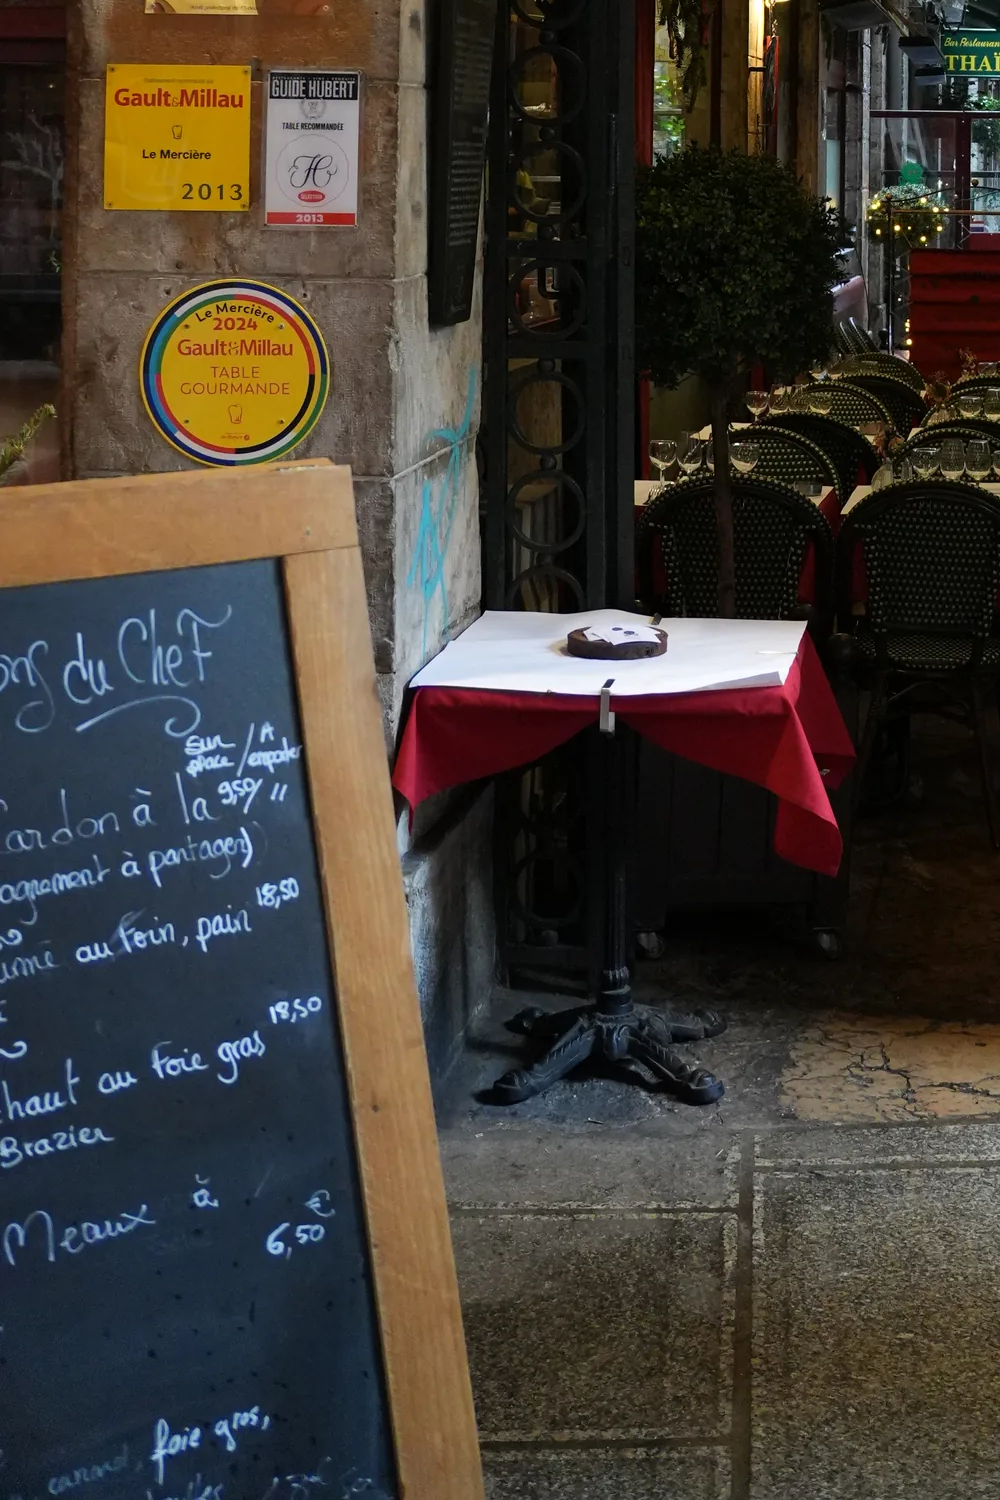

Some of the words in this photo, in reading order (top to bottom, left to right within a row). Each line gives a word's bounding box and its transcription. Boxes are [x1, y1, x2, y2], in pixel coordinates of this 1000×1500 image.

[944, 37, 958, 47] Bar
[114, 88, 244, 108] Gault&Millau
[272, 80, 306, 97] GUIDE
[308, 80, 356, 98] HUBERT
[282, 122, 300, 130] TABLE
[301, 122, 344, 131] RECOMMANDÉE
[142, 149, 156, 159] Le
[160, 149, 212, 160] Mercière
[181, 183, 243, 201] 2013
[296, 214, 324, 223] 2013
[195, 309, 213, 323] Le
[216, 302, 274, 323] Mercière
[213, 317, 258, 331] 2024
[211, 366, 260, 379] TABLE
[180, 382, 291, 395] GOURMANDE
[63, 632, 114, 704] du
[175, 771, 222, 825] la
[121, 850, 141, 877] à
[76, 942, 113, 964] au
[197, 904, 252, 953] pain
[256, 877, 300, 909] 18,50
[98, 1070, 138, 1094] au
[217, 1031, 266, 1085] gras
[269, 995, 322, 1024] 18,50
[4, 1203, 156, 1267] Meaux
[265, 1222, 326, 1260] 6,50
[151, 1417, 201, 1486] foie
